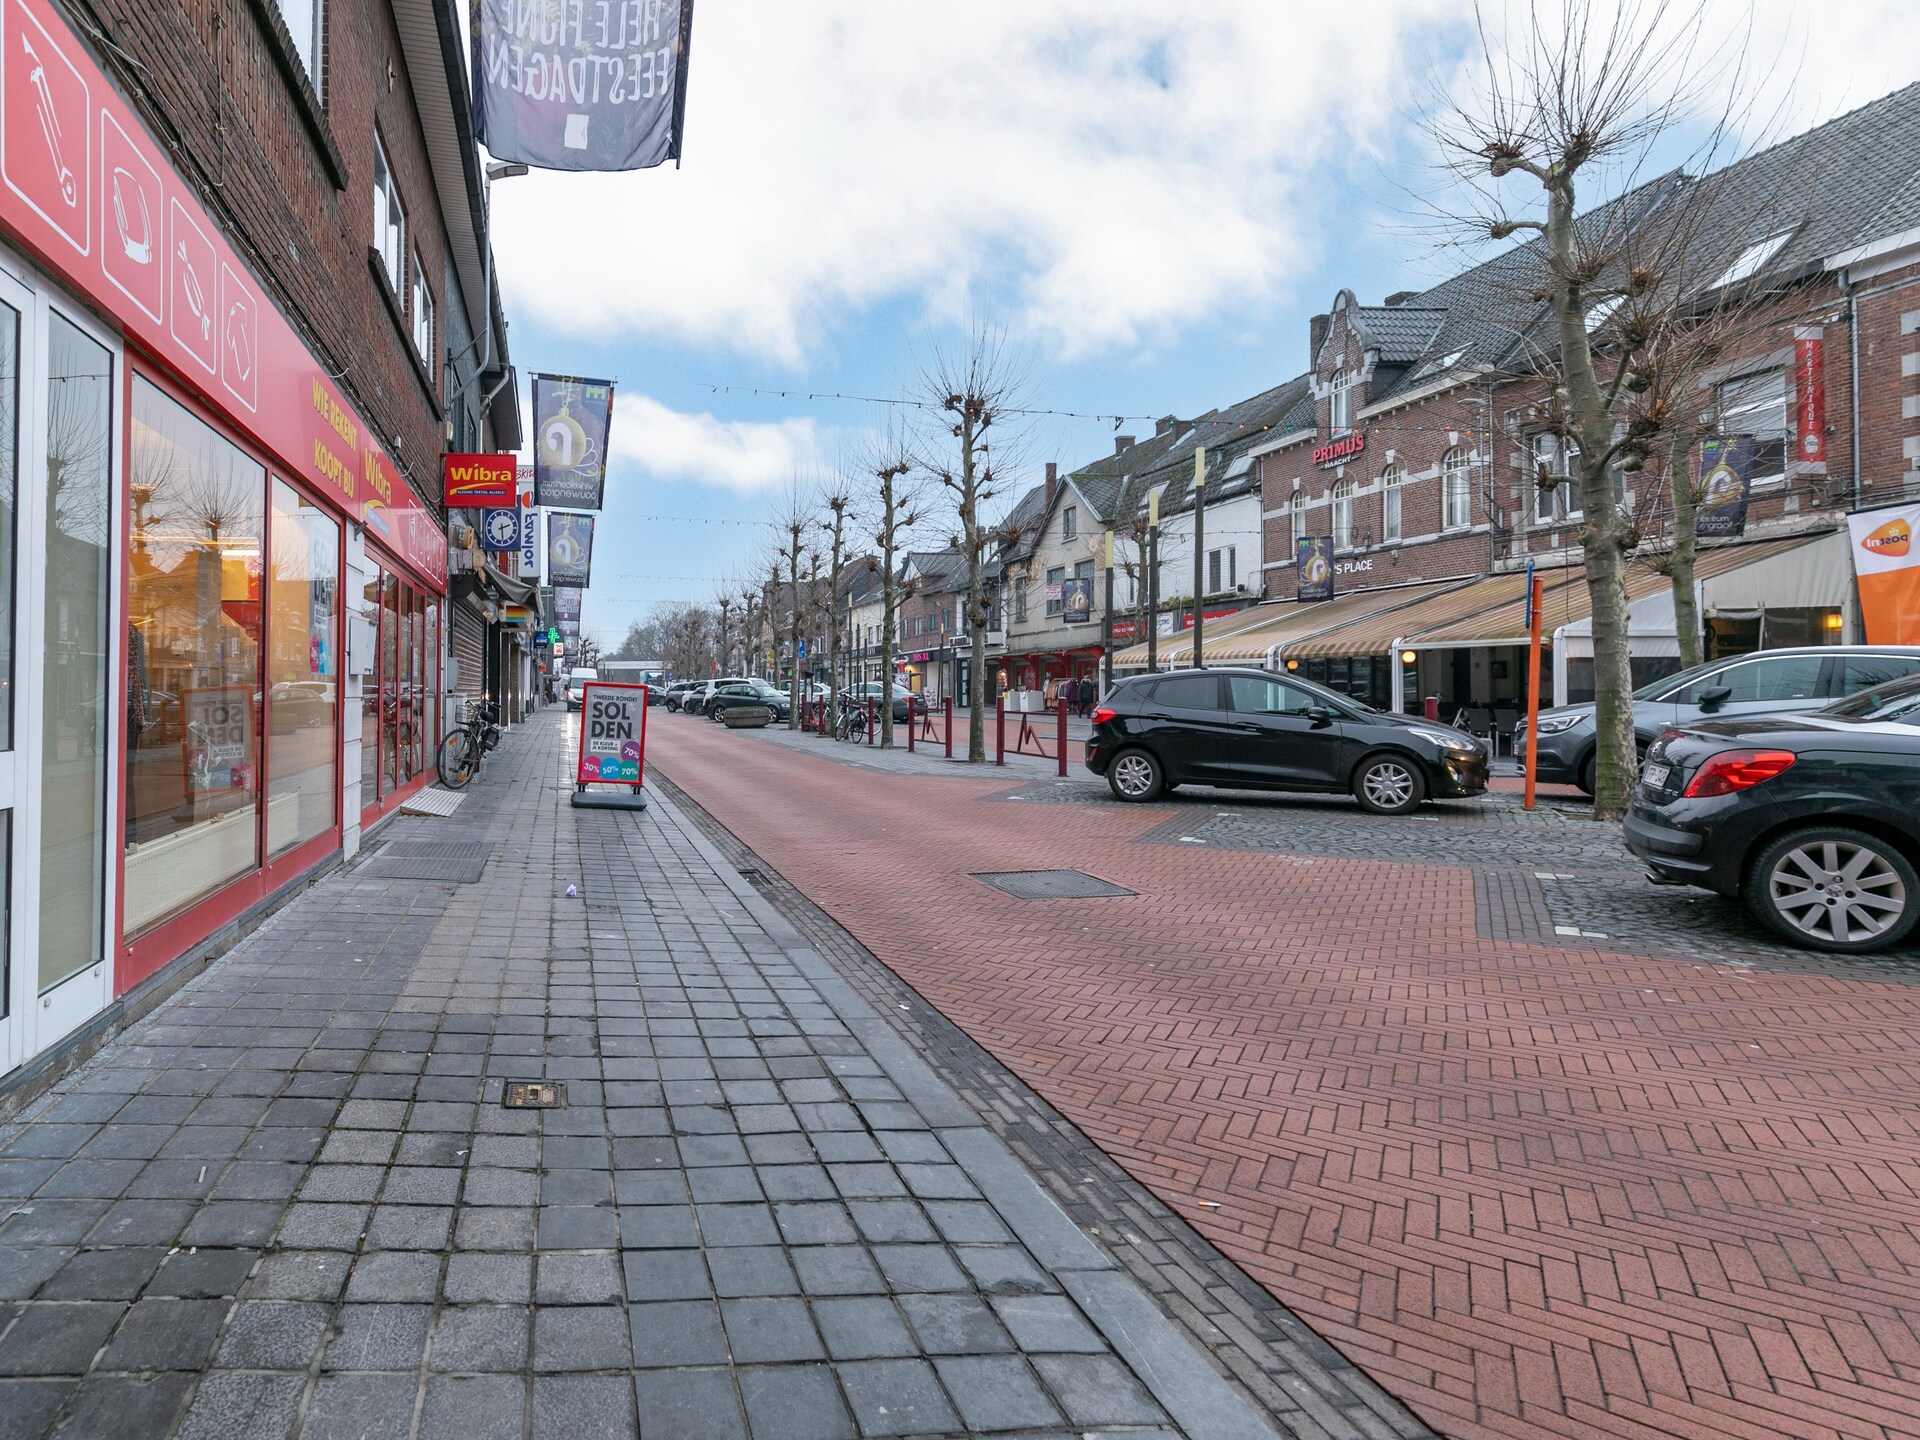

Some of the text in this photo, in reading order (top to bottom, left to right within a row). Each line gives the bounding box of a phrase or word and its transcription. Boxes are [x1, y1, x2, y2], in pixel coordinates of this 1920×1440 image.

[312, 377, 357, 451] WIE REKENT
[1312, 435, 1364, 464] PRIMUS
[314, 438, 354, 499] KOOPT BIJ
[450, 463, 512, 481] Wibra
[1325, 457, 1352, 469] HAACHT
[365, 448, 391, 504] Wibra
[1344, 559, 1373, 574] PLACE
[592, 702, 630, 720] SOL
[591, 721, 632, 739] DEN
[624, 747, 640, 759] 70%
[584, 762, 600, 774] 30%
[602, 766, 619, 775] 50%
